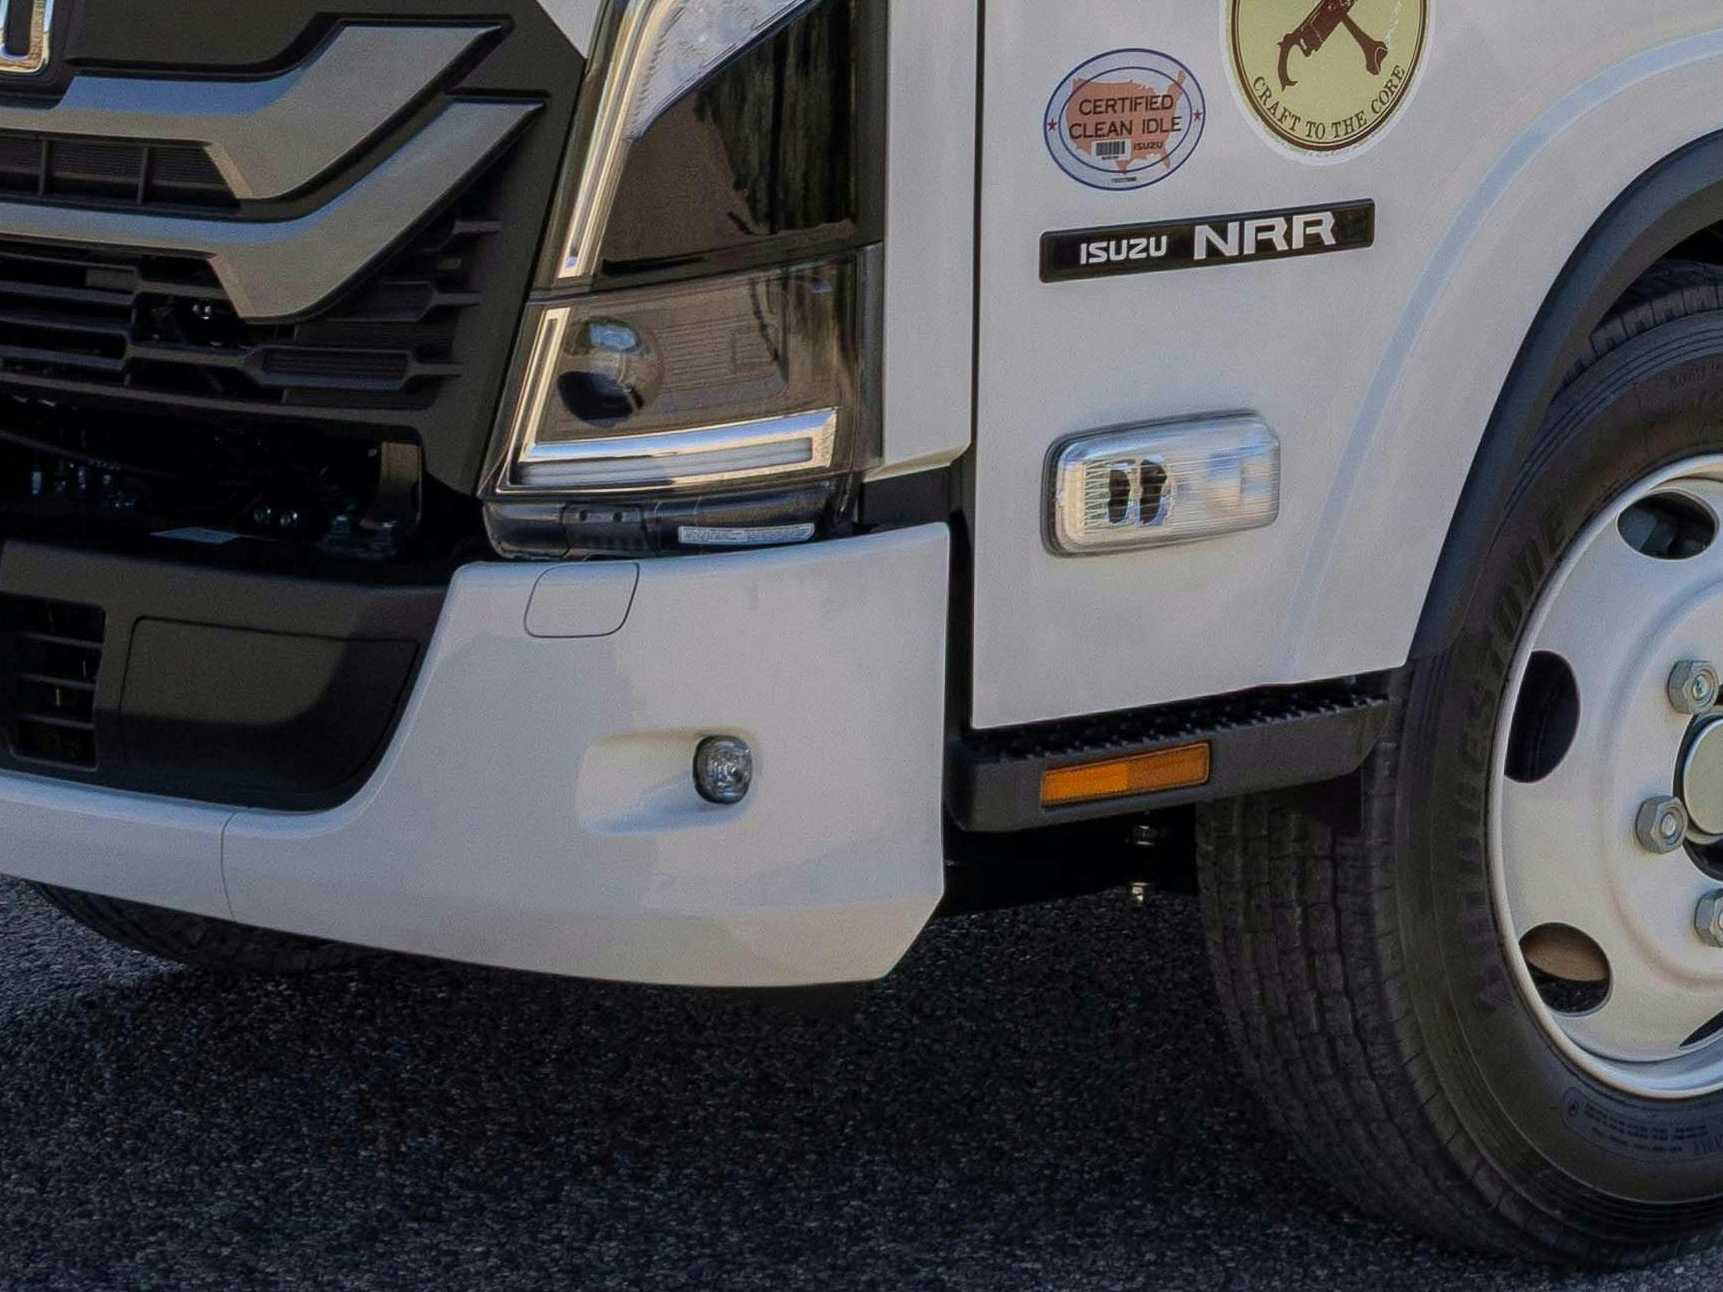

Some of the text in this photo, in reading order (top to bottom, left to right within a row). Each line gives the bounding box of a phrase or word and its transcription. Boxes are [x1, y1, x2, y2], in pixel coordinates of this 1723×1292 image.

[1078, 94, 1174, 116] CERTIFIED
[1252, 64, 1406, 141] CRAFT TO THE CORE
[1068, 116, 1183, 140] CLEAN IDLE
[1133, 140, 1164, 151] ISUZU
[1079, 210, 1337, 266] ISUZU NRR
